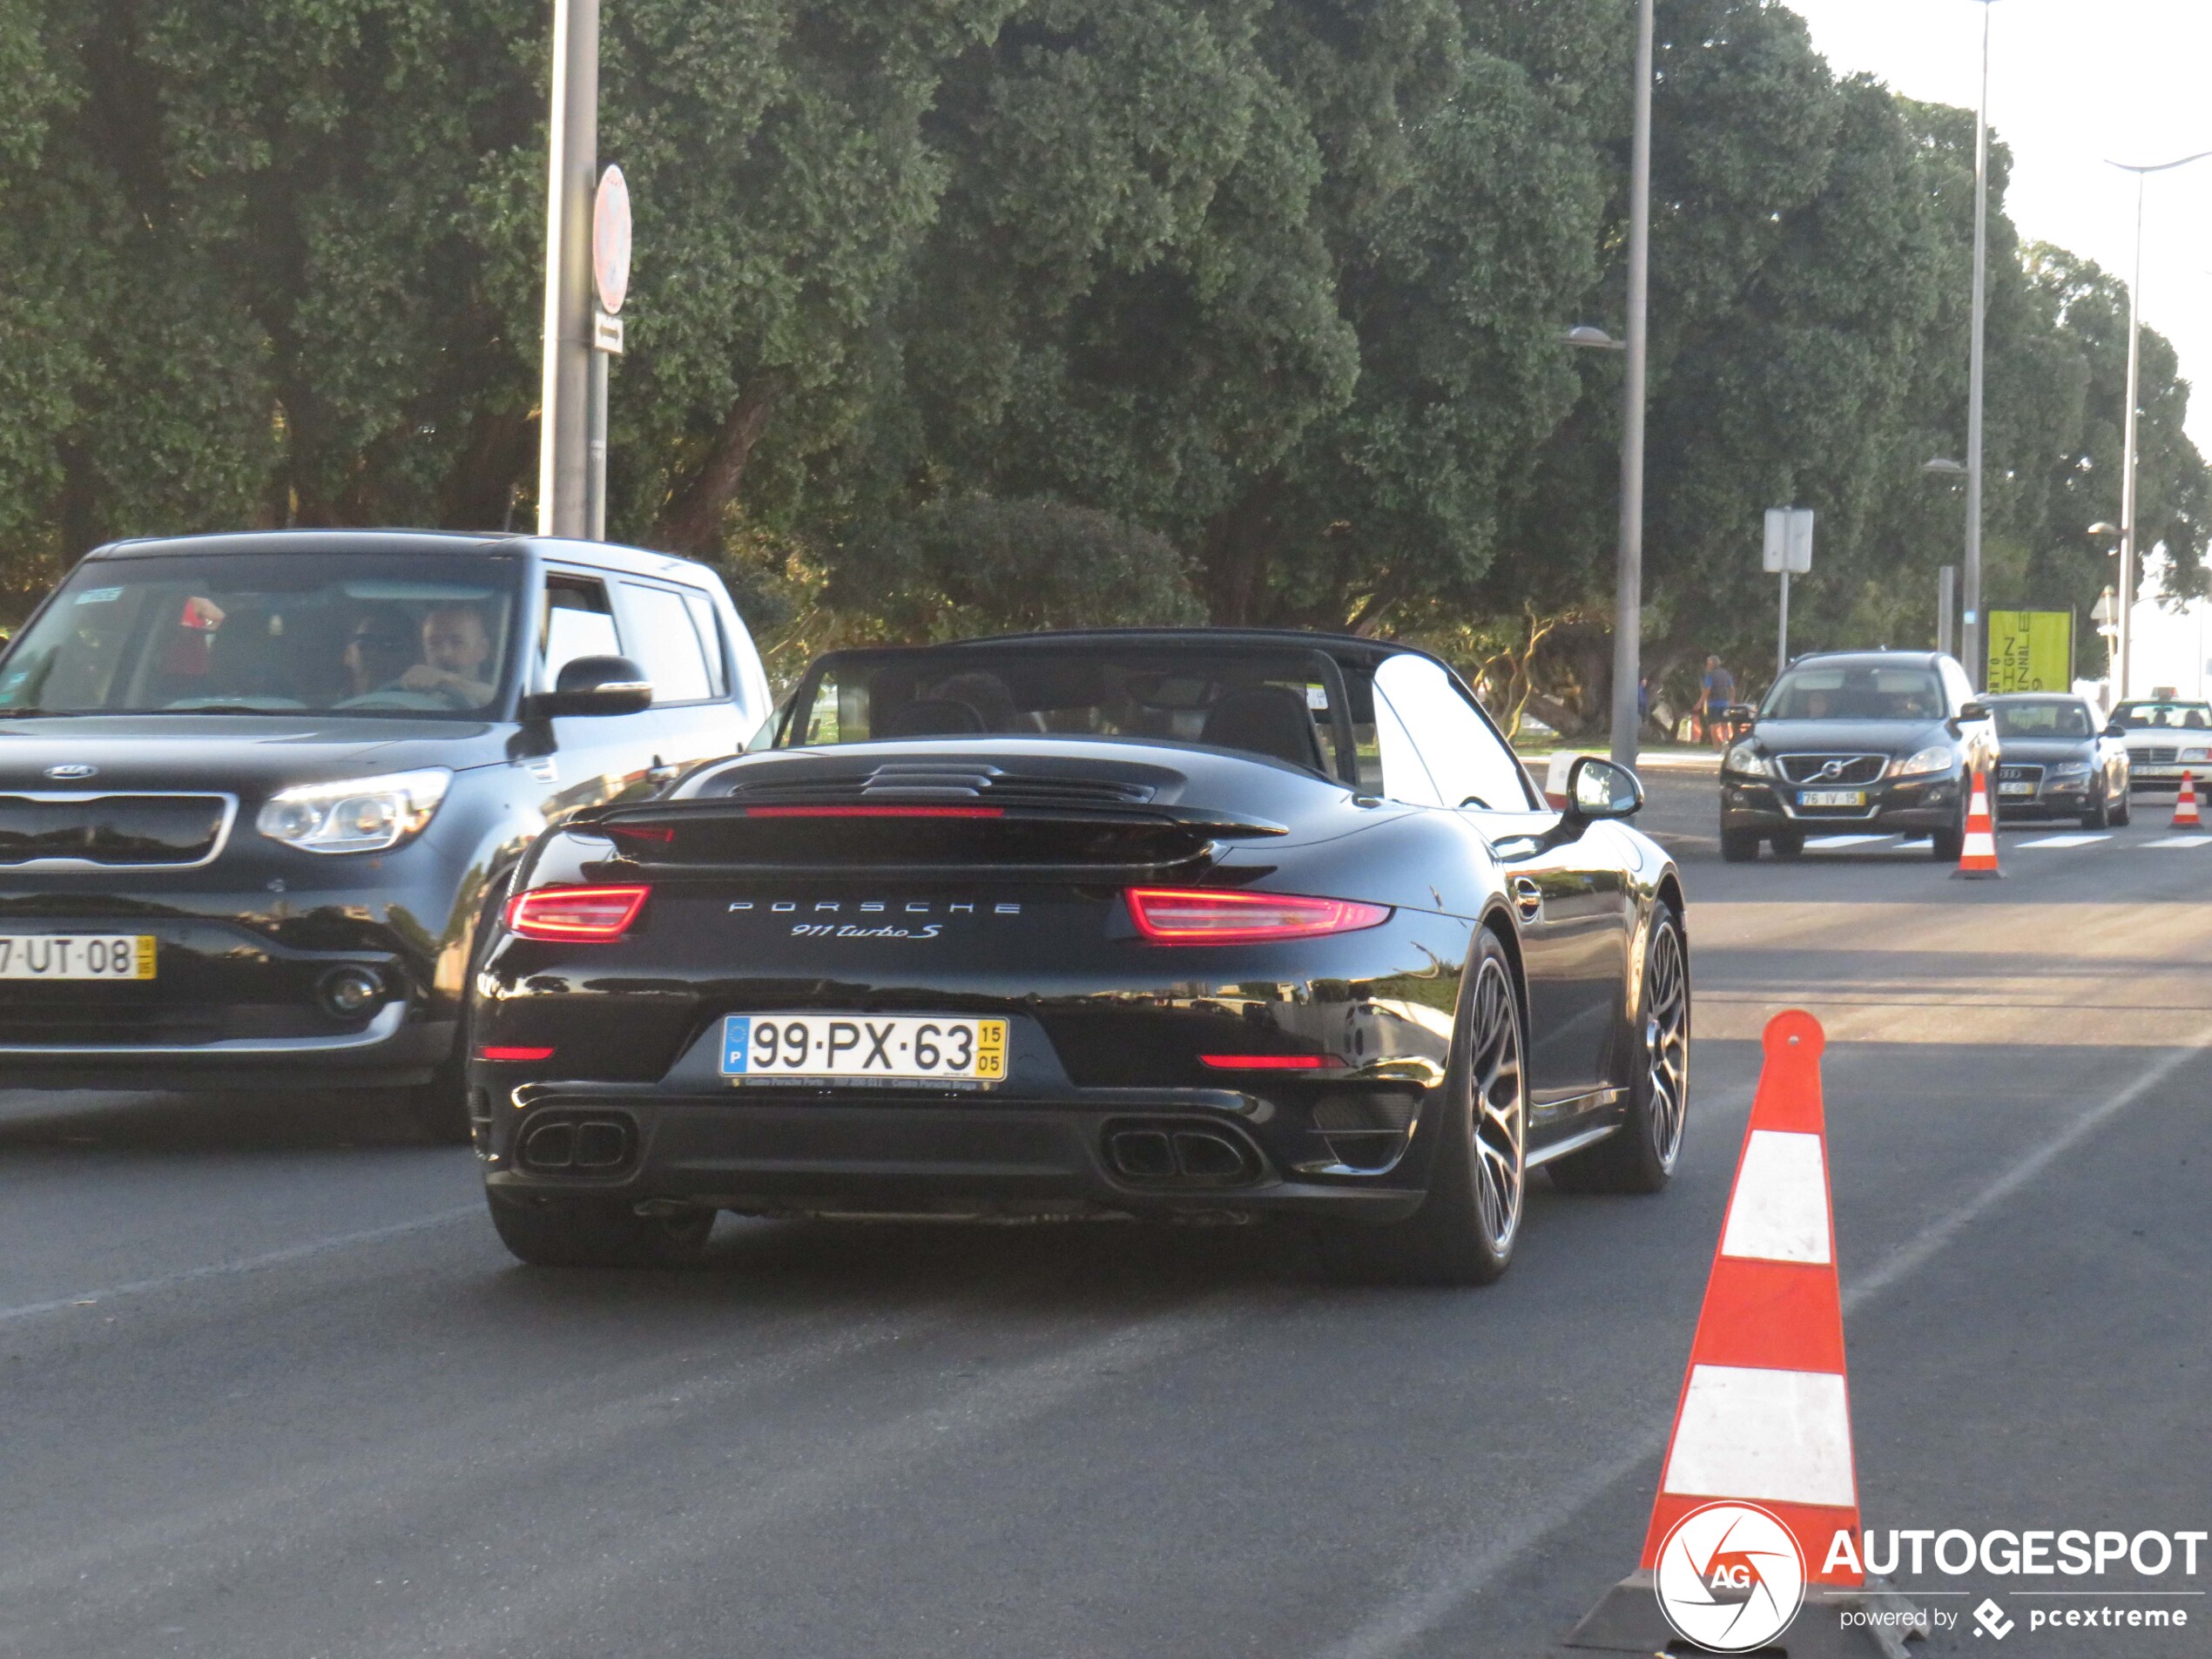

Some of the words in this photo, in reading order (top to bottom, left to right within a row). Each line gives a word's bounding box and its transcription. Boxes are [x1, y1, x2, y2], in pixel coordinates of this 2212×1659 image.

[728, 901, 1022, 914] PORSCHE
[791, 924, 833, 936] 911
[907, 925, 943, 938] S
[982, 1027, 1001, 1042] 15
[730, 1051, 741, 1063] P
[978, 1055, 1000, 1071] 05
